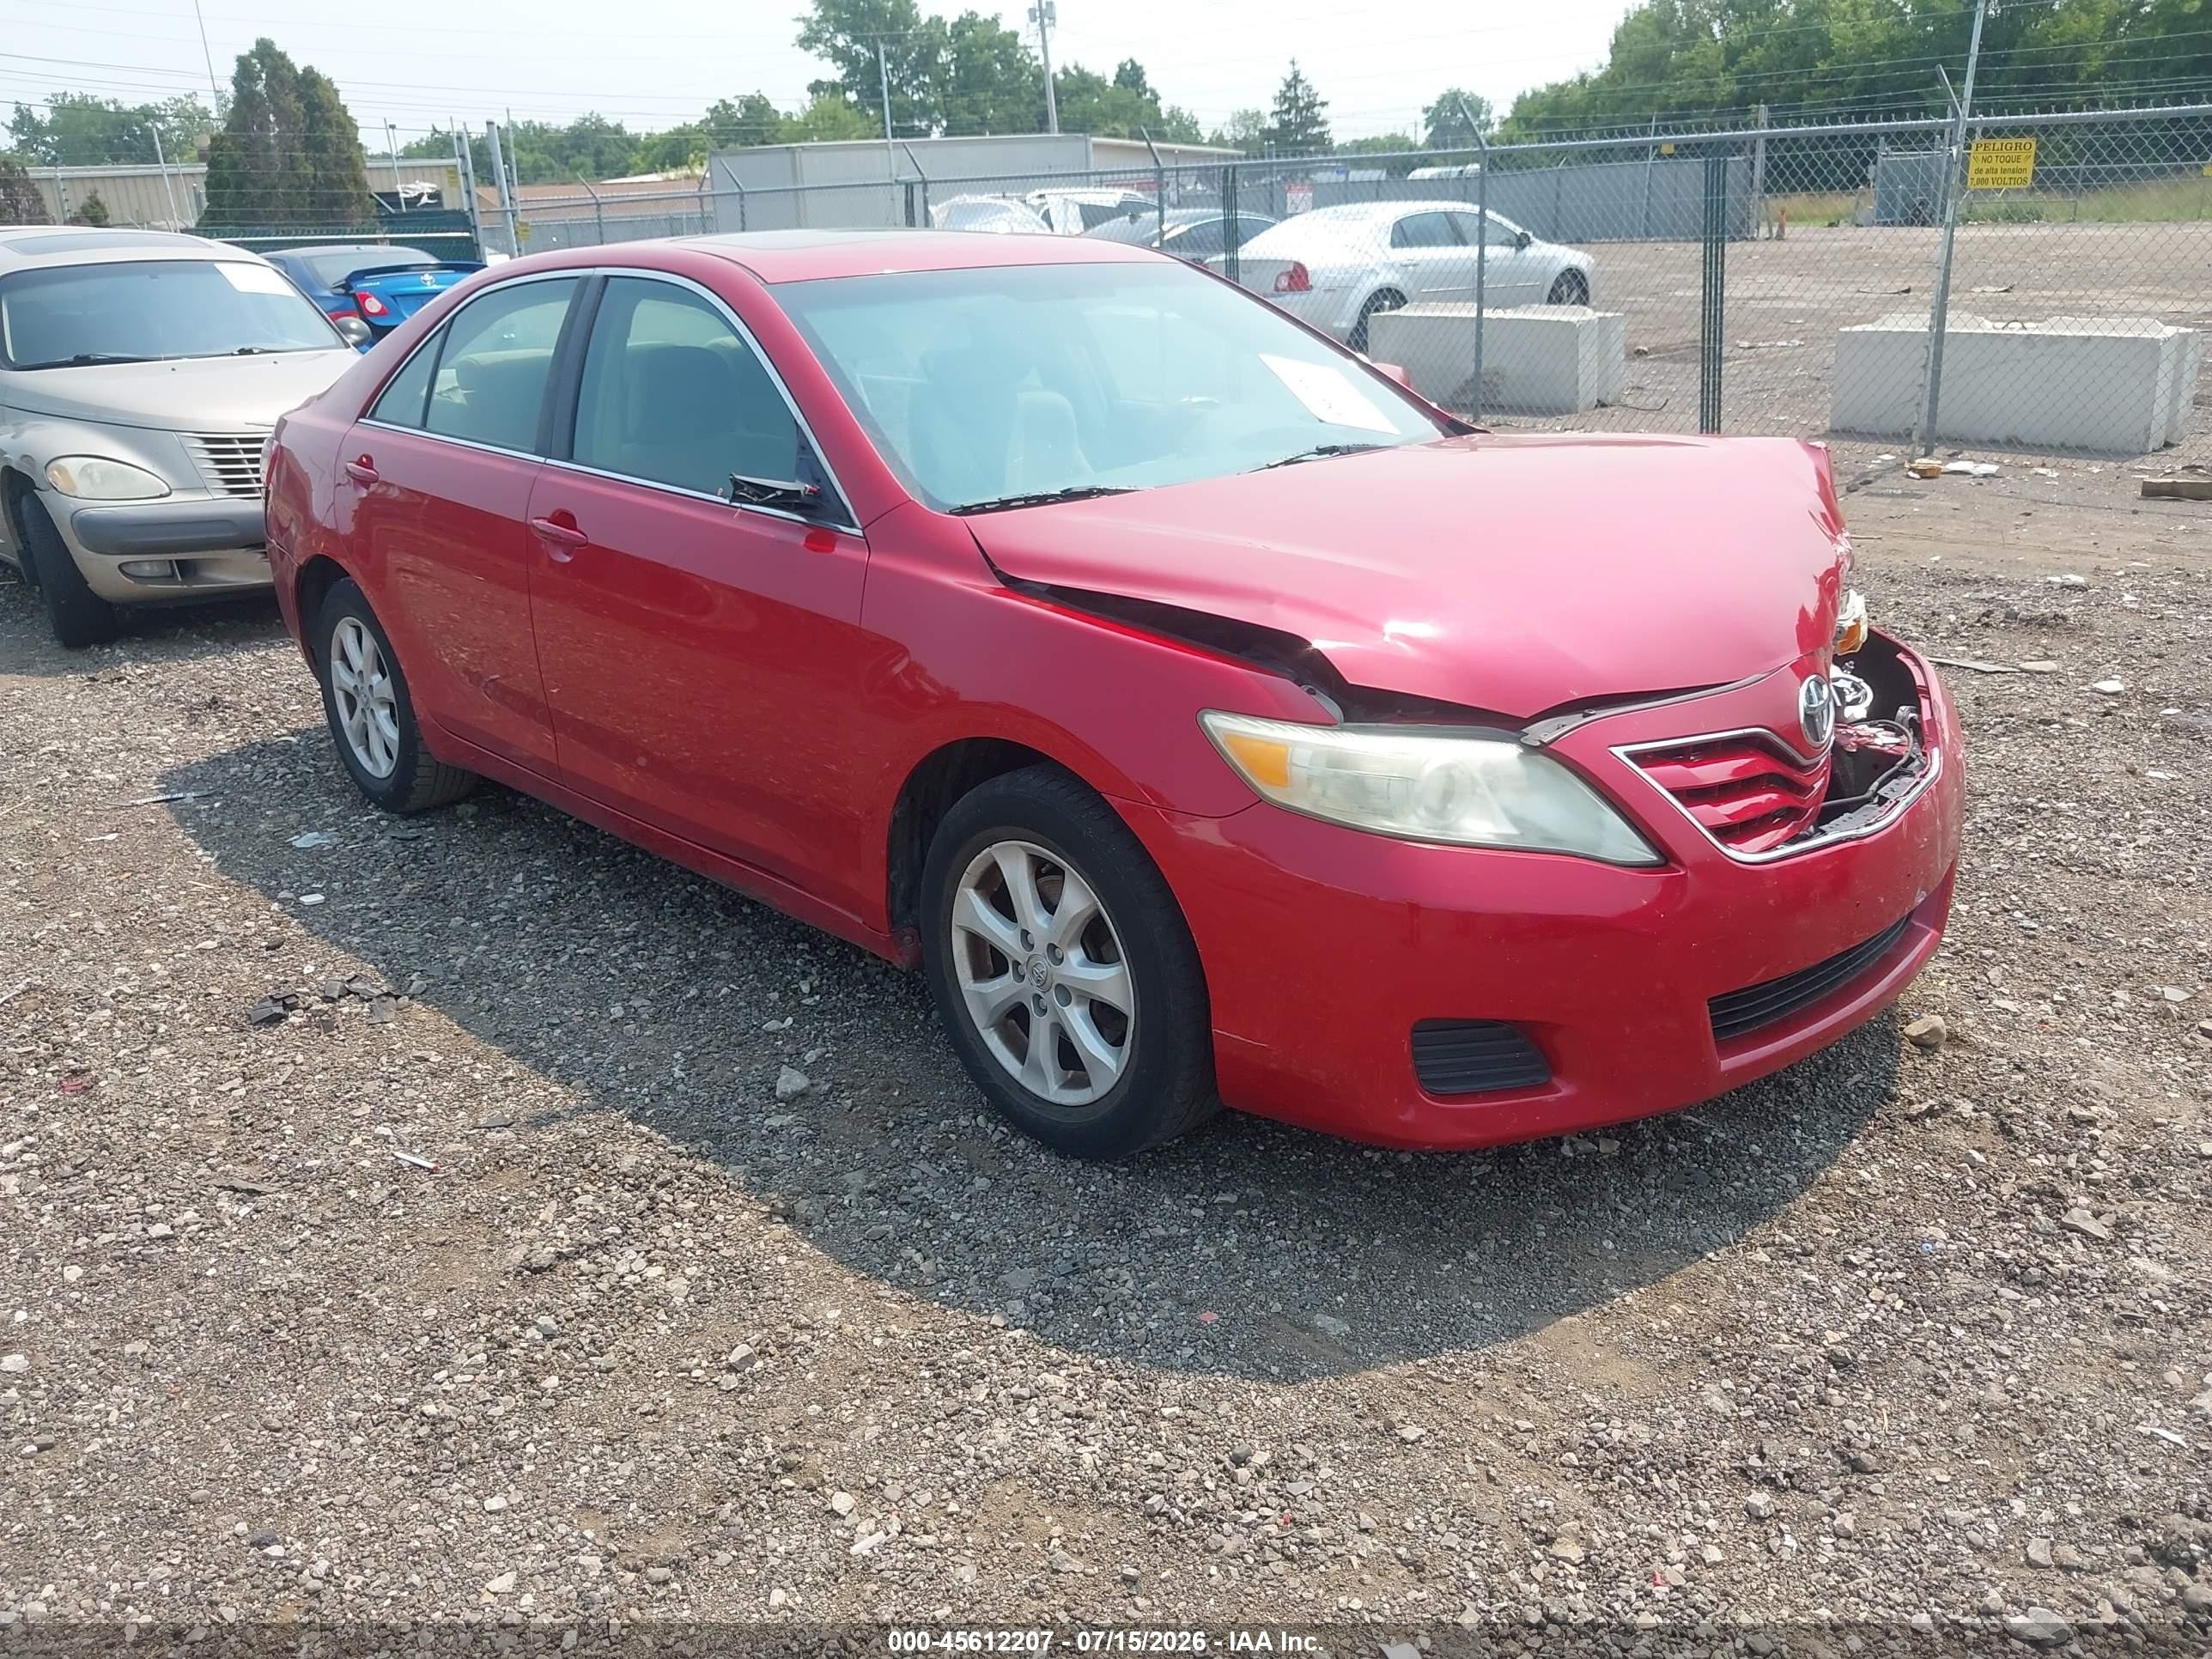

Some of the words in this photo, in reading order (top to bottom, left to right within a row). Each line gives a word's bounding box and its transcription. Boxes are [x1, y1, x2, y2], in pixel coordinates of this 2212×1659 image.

[1975, 142, 2033, 152] PELIGRO
[1981, 155, 1993, 164] NO
[1995, 155, 2022, 164] TOQUE
[1984, 166, 1998, 174] alta
[1991, 176, 2028, 185] VOLTIOS
